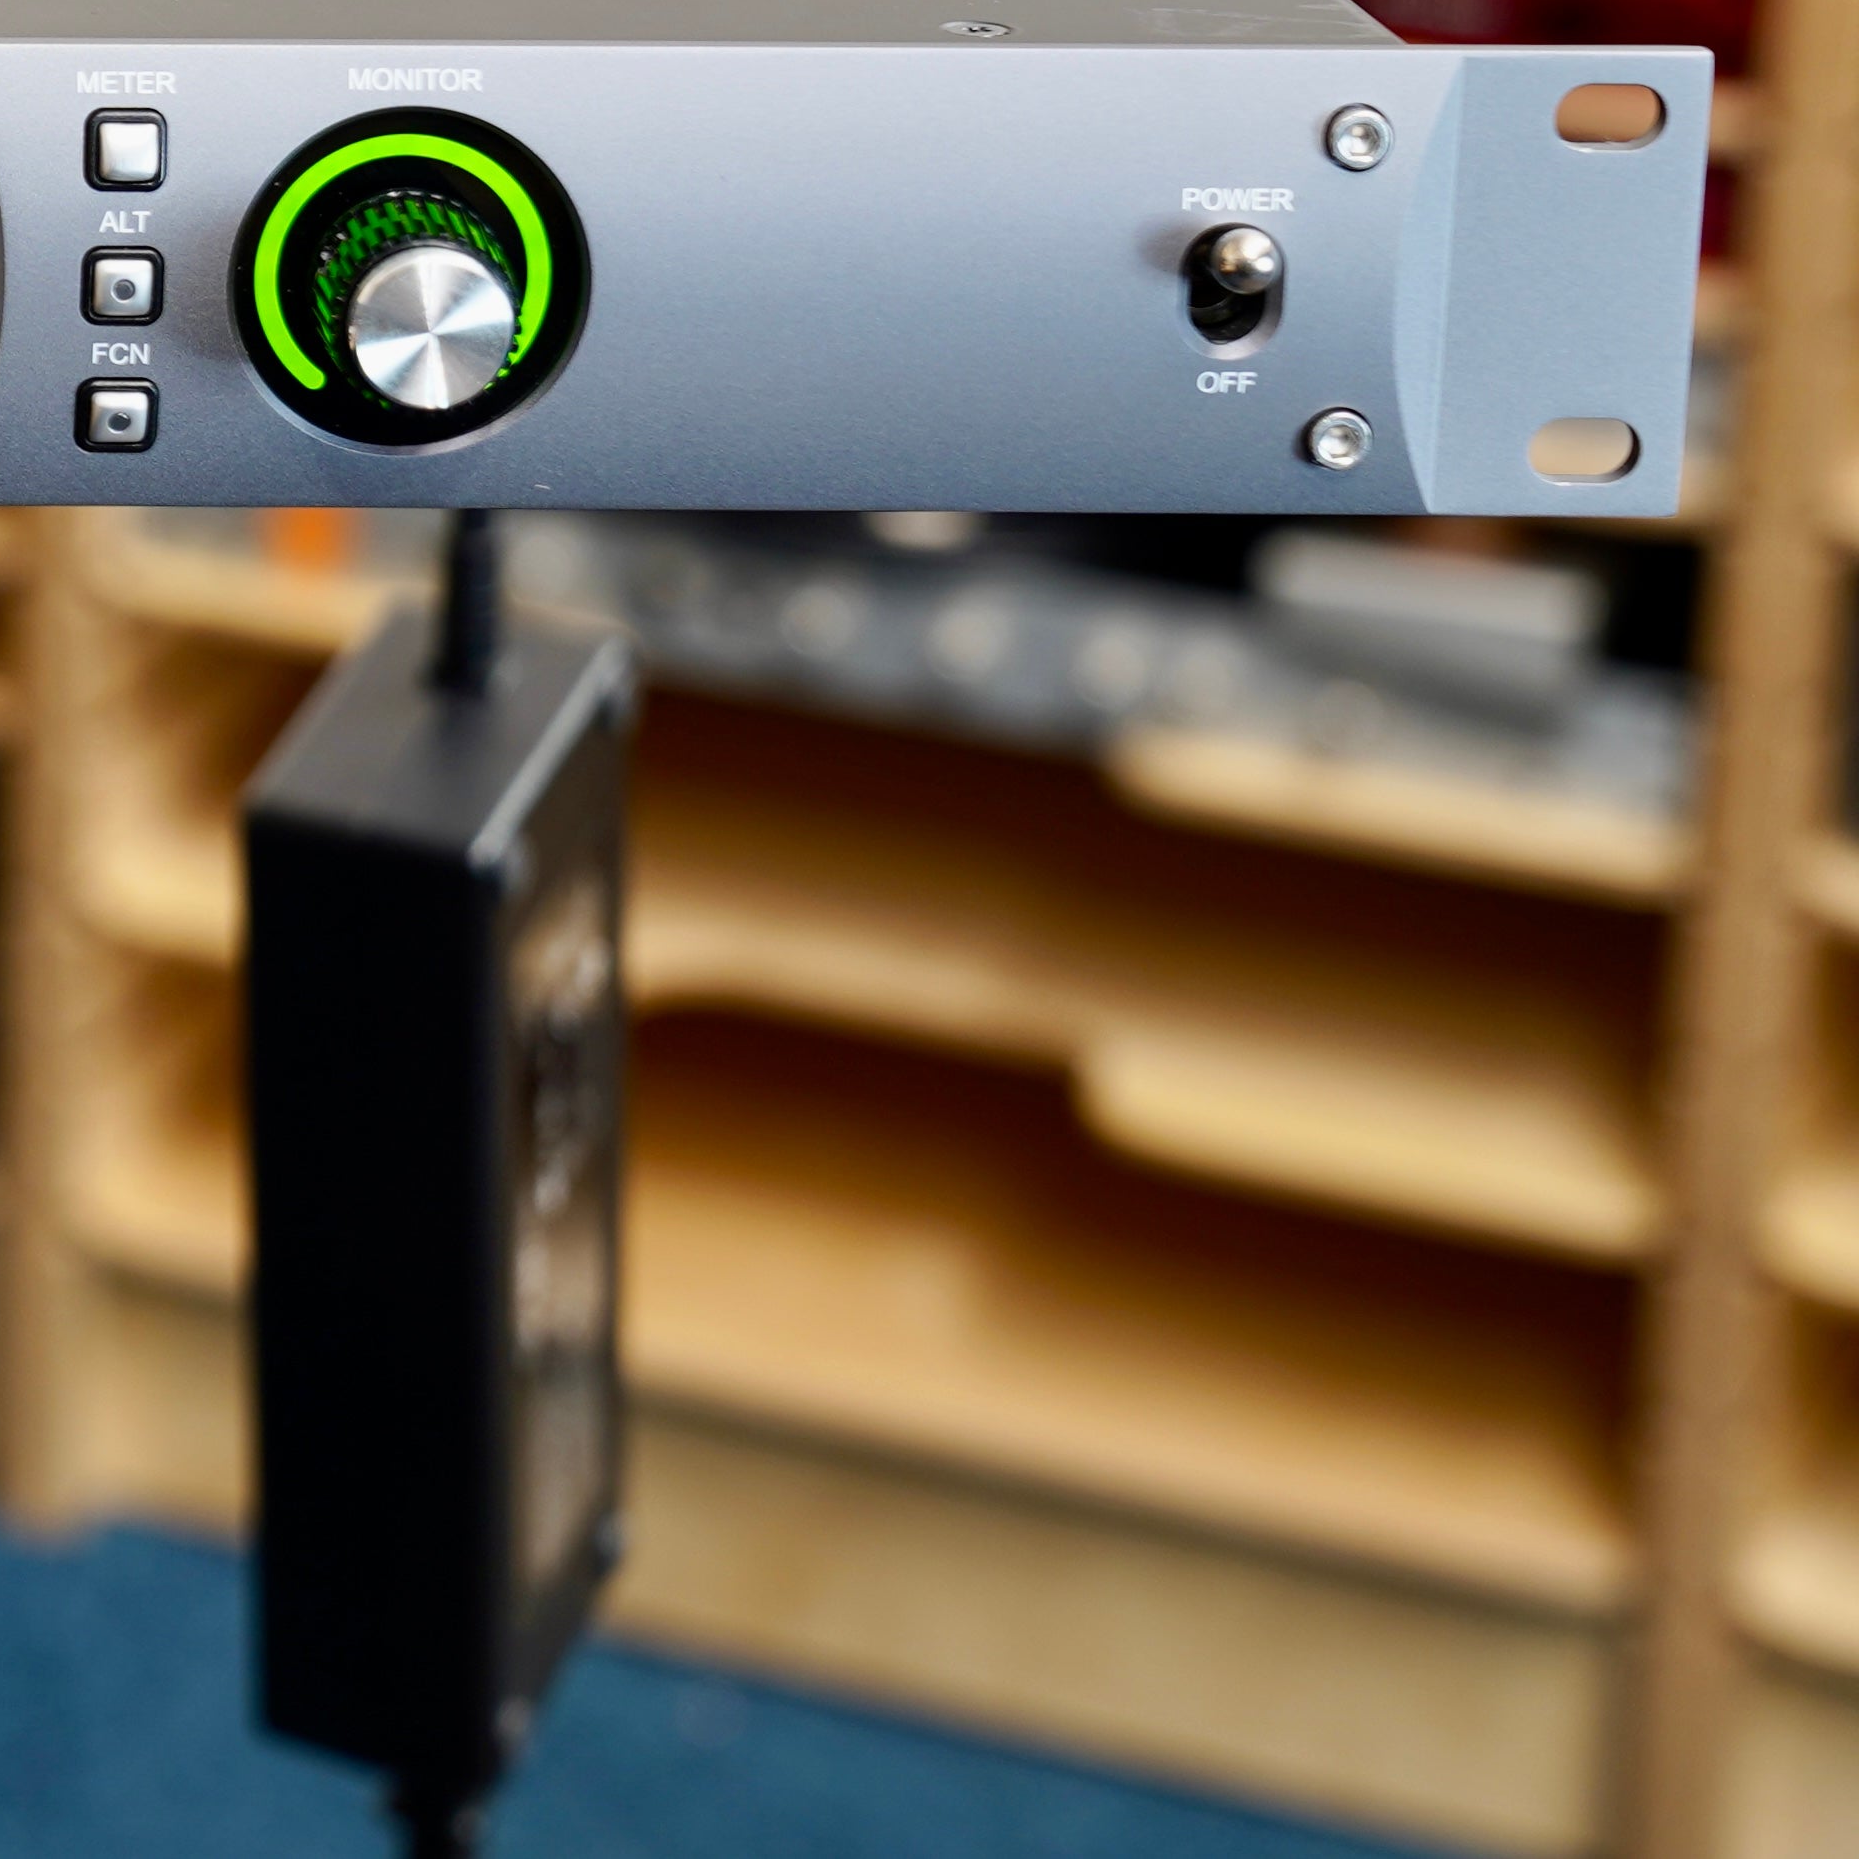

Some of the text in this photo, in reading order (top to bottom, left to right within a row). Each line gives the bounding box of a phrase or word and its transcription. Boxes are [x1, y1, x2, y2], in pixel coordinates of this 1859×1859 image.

[77, 71, 176, 94] METER
[348, 67, 483, 92] MONITOR
[1182, 187, 1293, 211] POWER
[99, 210, 151, 233] ALT
[92, 342, 149, 365] FCN
[1197, 371, 1257, 393] OFF
